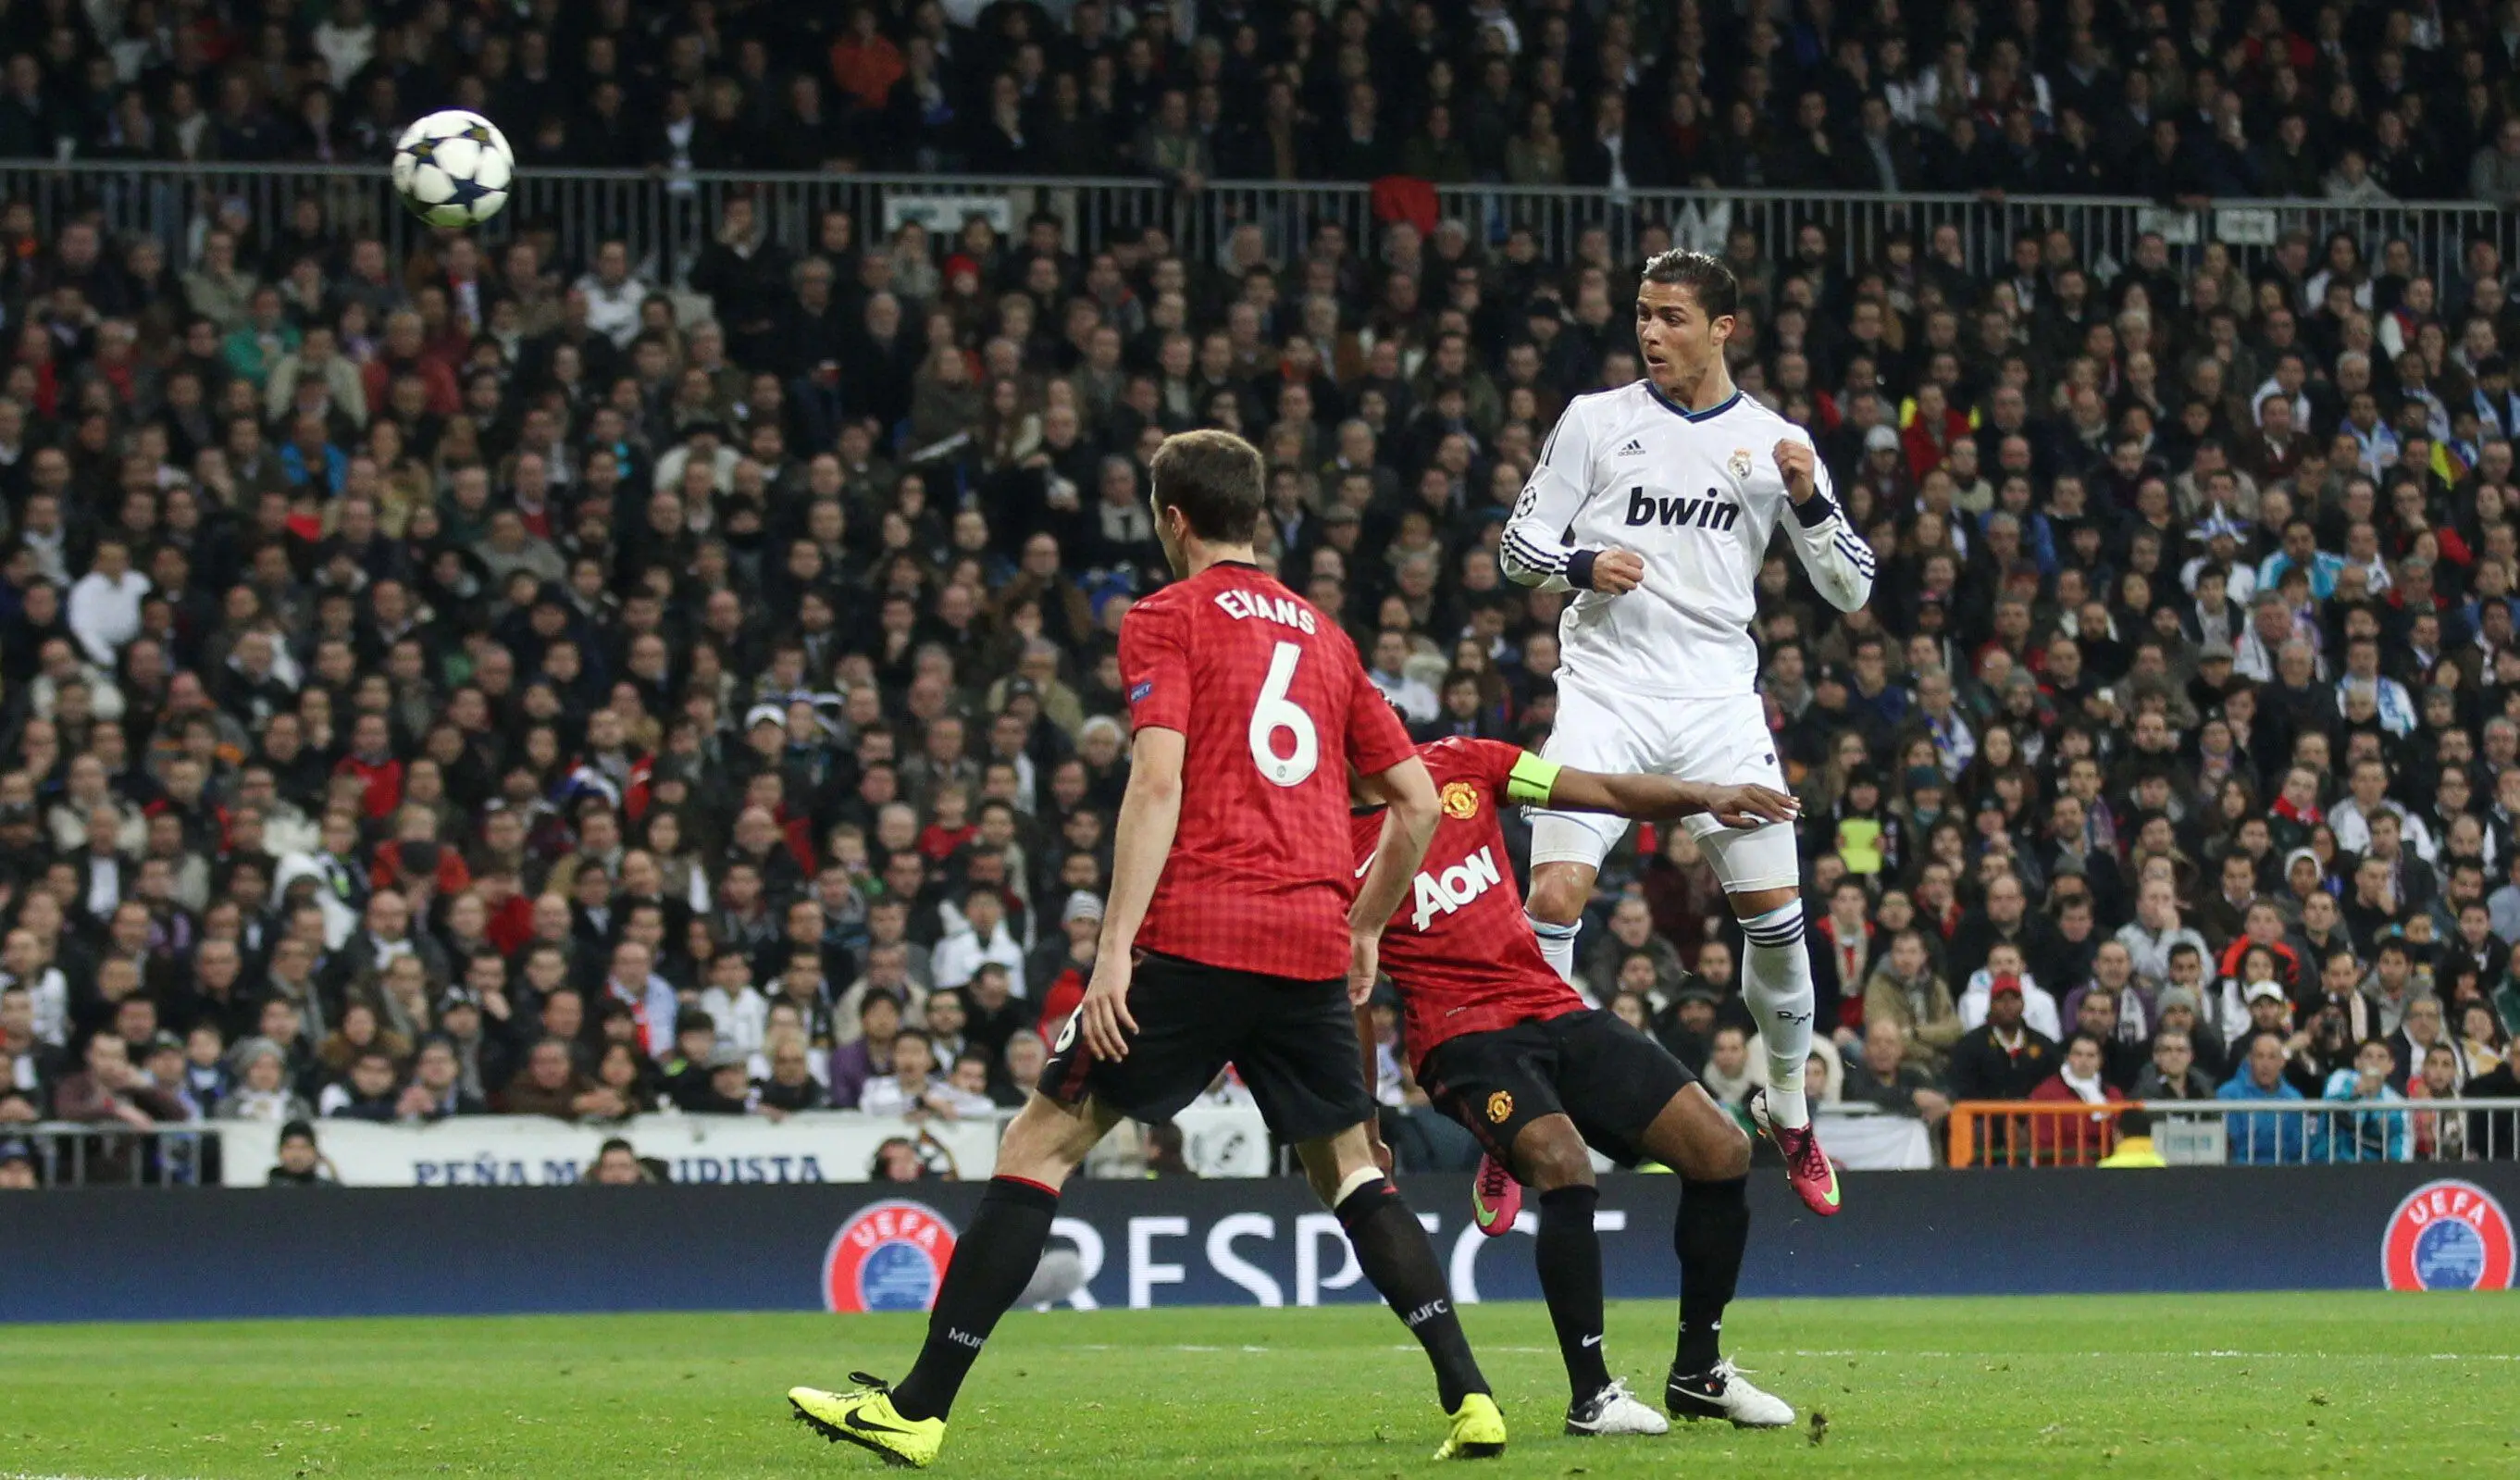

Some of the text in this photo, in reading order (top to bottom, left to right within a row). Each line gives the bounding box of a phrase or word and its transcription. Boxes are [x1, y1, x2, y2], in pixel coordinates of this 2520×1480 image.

[1625, 486, 1741, 531] bwin
[1214, 589, 1316, 636] EVANS
[1249, 641, 1318, 787] 6
[1411, 845, 1501, 932] AON
[542, 1154, 824, 1186] MIDISTA
[2408, 1189, 2487, 1226] UEFA
[851, 1211, 939, 1250] UEFA
[1033, 1210, 1626, 1311] RESPC
[1404, 1299, 1448, 1327] MUFC
[948, 1327, 987, 1349] MUF
